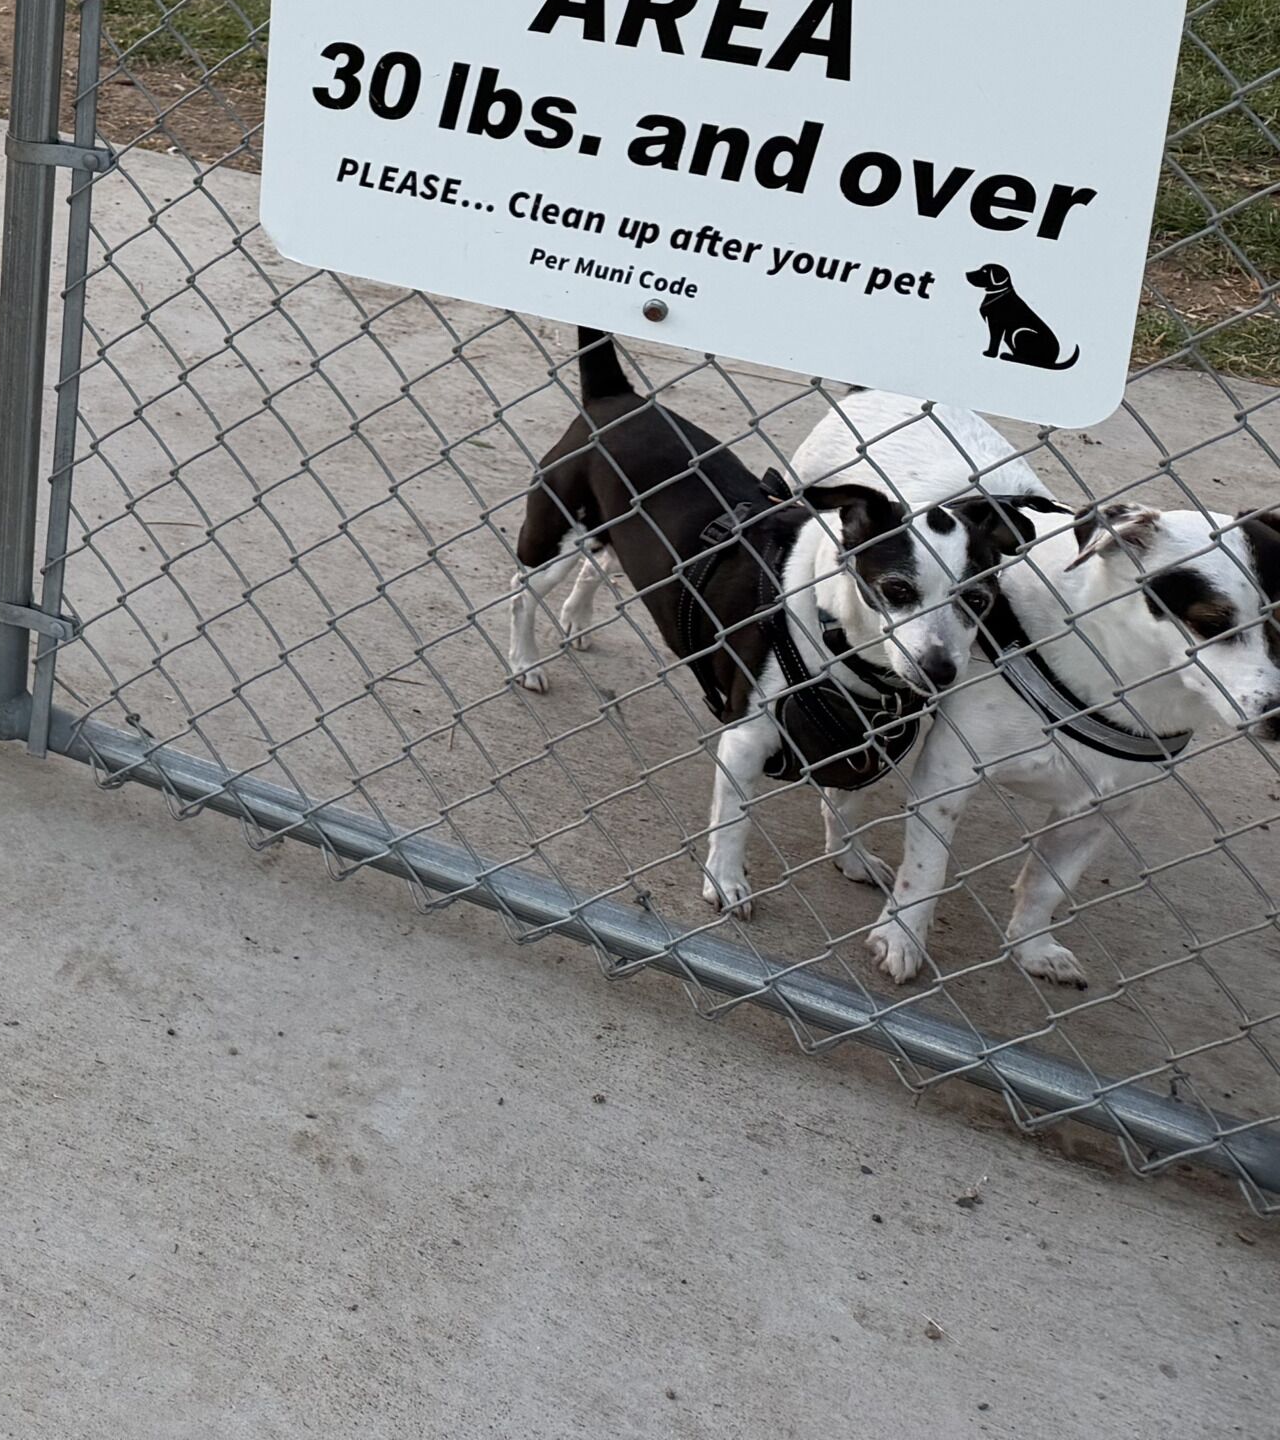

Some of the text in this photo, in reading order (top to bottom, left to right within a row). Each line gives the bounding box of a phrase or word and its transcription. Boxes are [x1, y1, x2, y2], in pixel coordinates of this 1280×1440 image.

[311, 41, 1098, 241] 30 lbs. and over
[336, 157, 936, 300] PLEASE... Clean up after your pet
[529, 247, 698, 299] Per Muni Code
